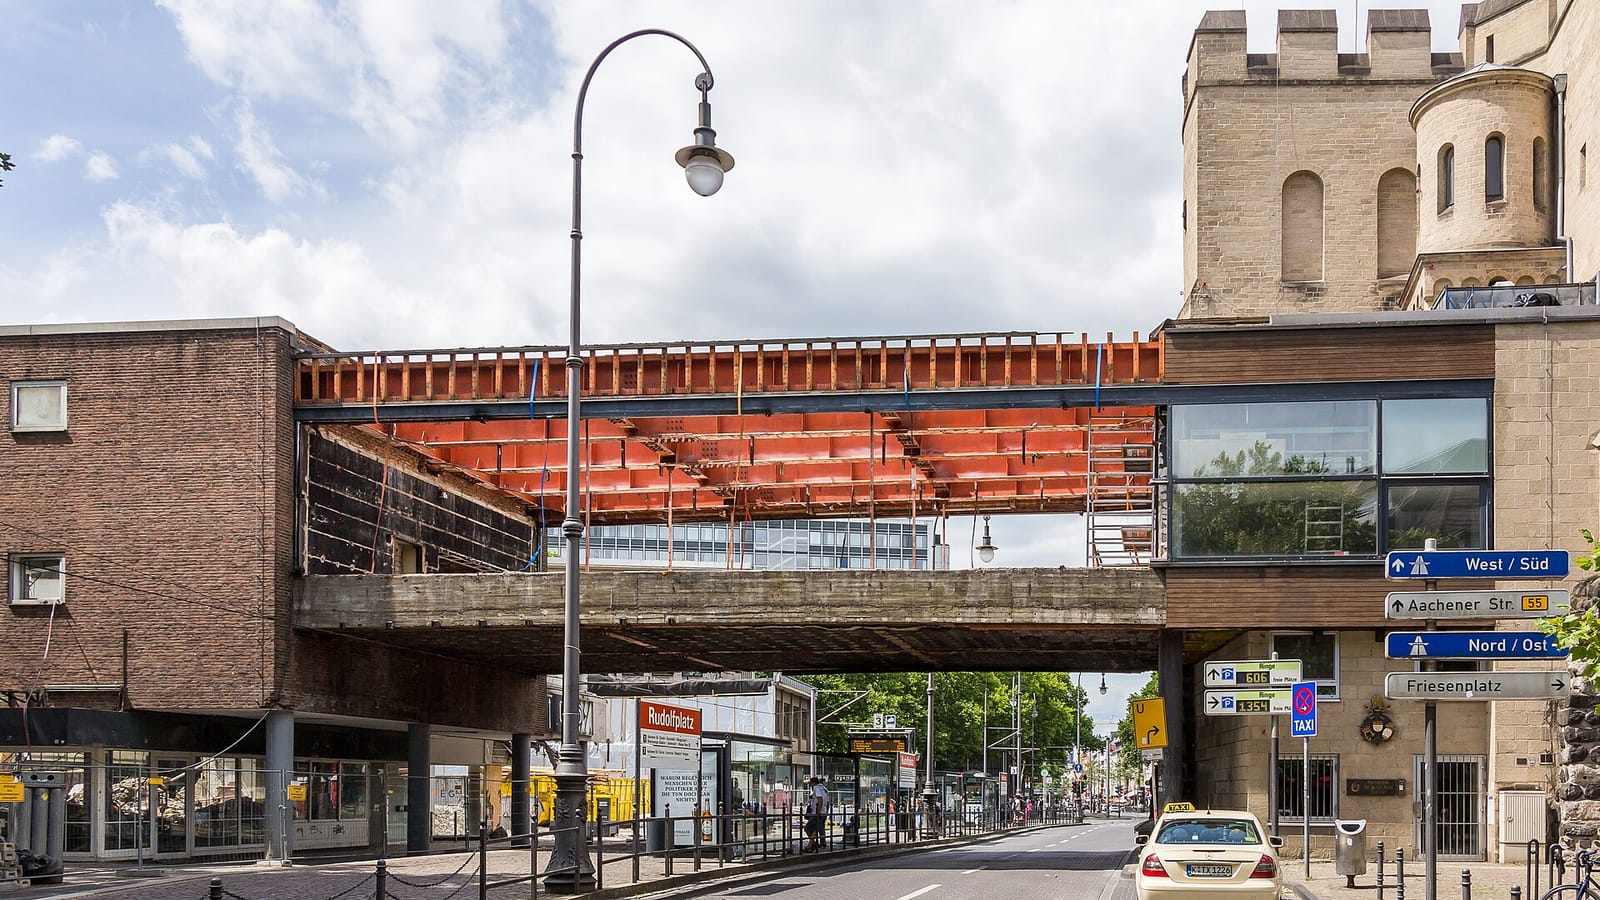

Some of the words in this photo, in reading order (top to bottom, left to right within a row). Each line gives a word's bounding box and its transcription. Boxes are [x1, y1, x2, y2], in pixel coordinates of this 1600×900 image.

[1465, 557, 1503, 571] West
[1519, 556, 1549, 571] Süd
[1407, 598, 1481, 612] Aachener
[1488, 597, 1515, 611] Str.
[1527, 597, 1542, 609] 55
[1468, 638, 1506, 652] Nord
[1522, 638, 1548, 652] Ost
[1246, 672, 1268, 683] 606
[1407, 679, 1502, 695] Friesenplatz
[1136, 703, 1145, 714] U
[1239, 701, 1268, 712] 1354
[648, 706, 695, 731] Rudolfplatz
[875, 717, 882, 725] 3
[1293, 719, 1315, 732] TAXI
